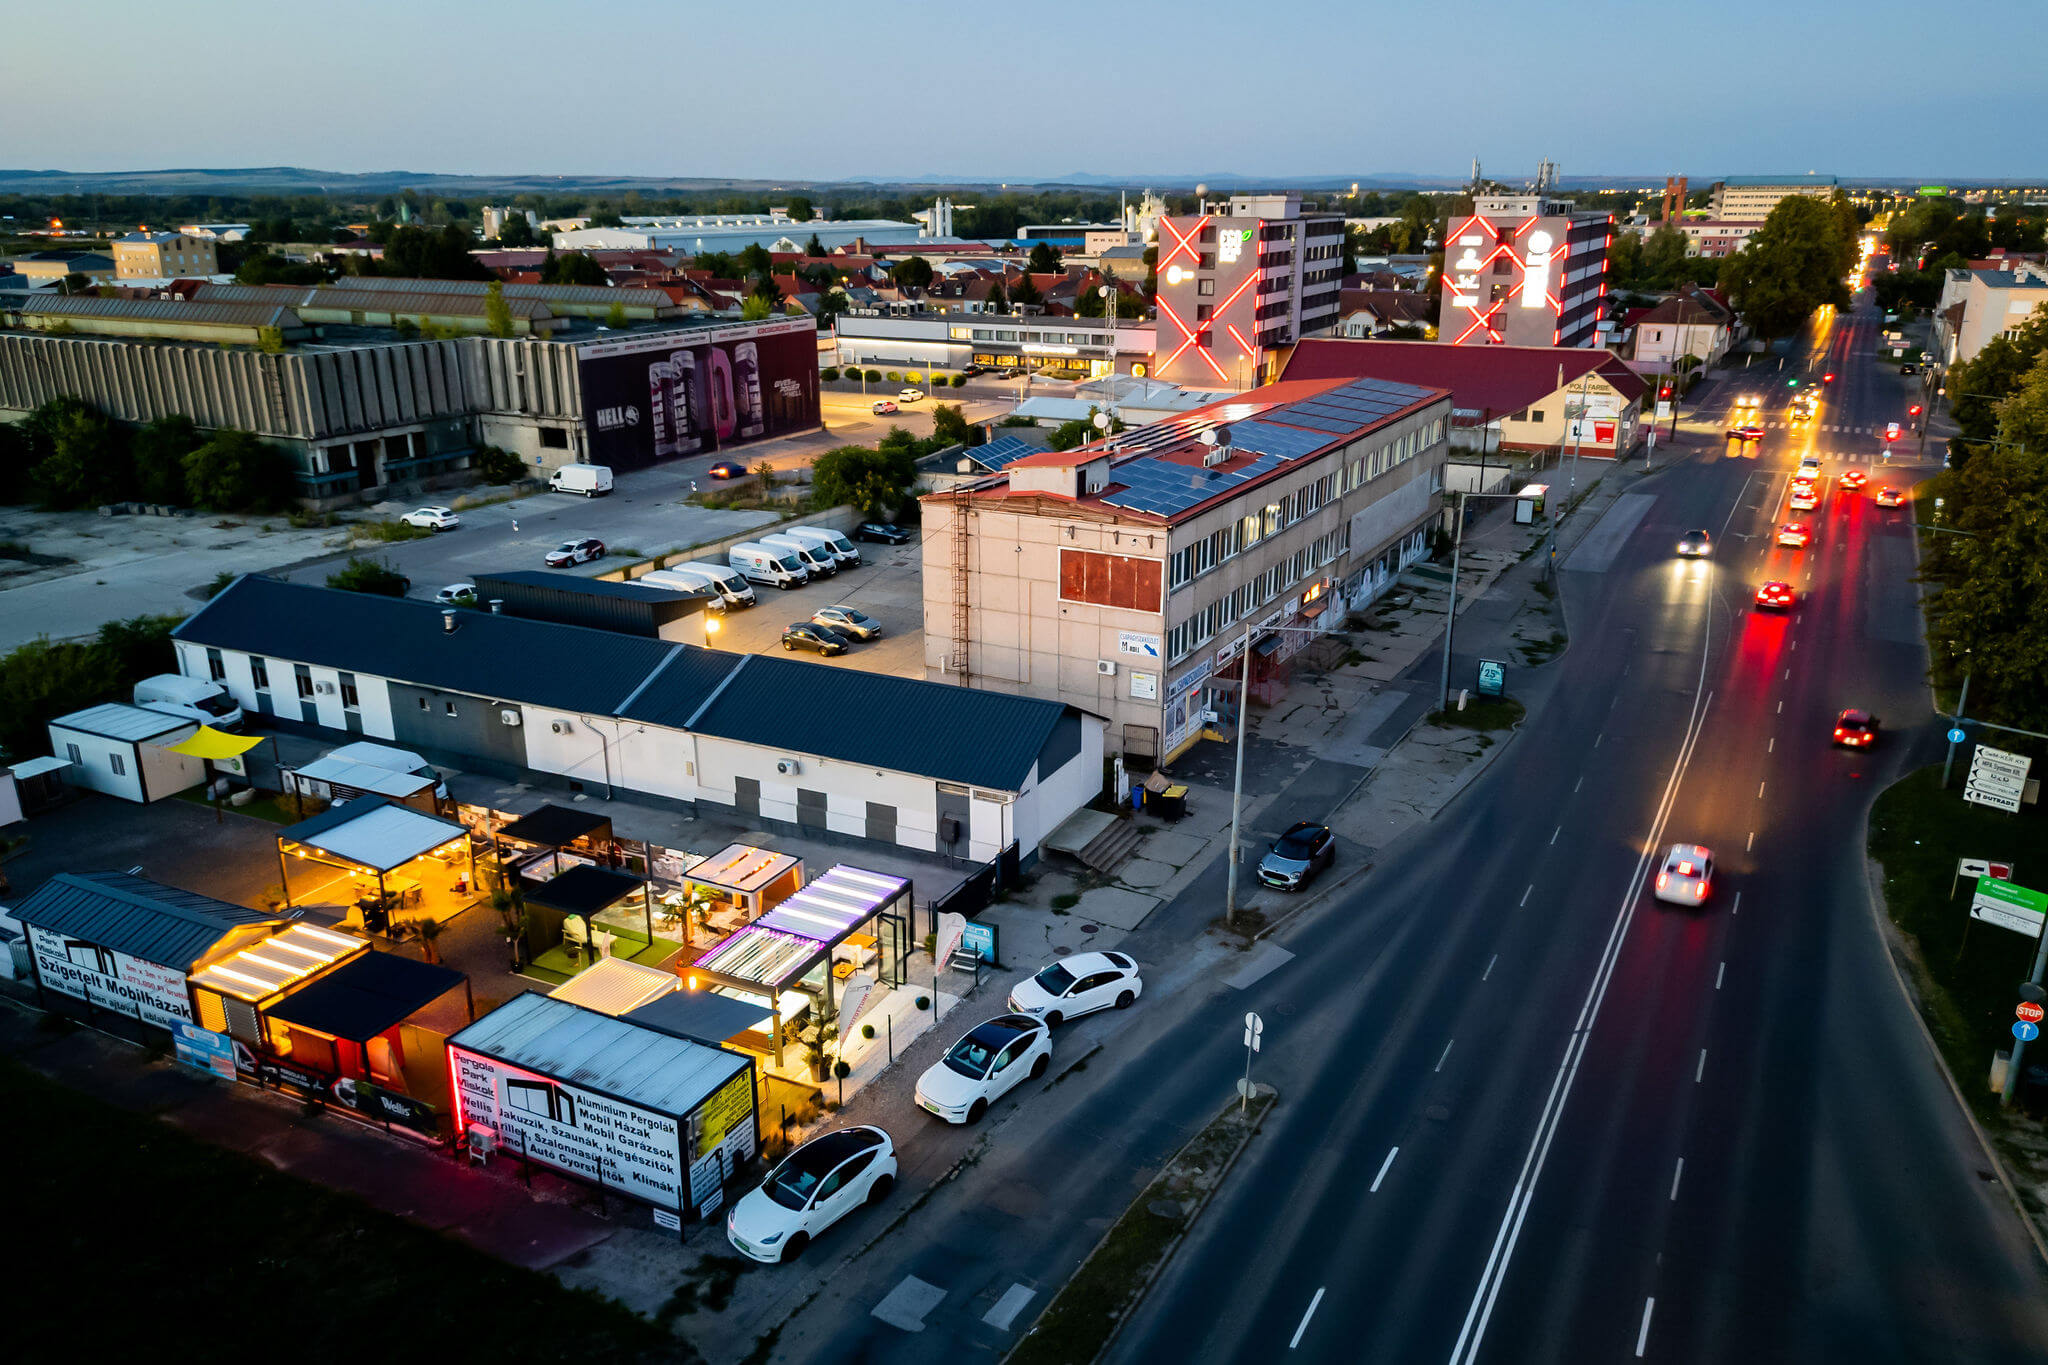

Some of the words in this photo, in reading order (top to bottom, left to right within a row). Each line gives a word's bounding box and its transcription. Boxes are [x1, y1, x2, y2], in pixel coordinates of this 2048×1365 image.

[673, 382, 688, 435] HELL
[747, 371, 762, 419] HELL
[596, 406, 624, 428] HELL
[652, 390, 666, 440] HELL
[39, 934, 58, 947] Park
[39, 956, 102, 989] Szigetelt
[106, 978, 192, 1020] Mobilházak
[2018, 1006, 2042, 1018] STOP
[453, 1052, 494, 1073] Pergola
[462, 1068, 488, 1083] Park
[381, 1096, 411, 1117] Wellis
[463, 1108, 490, 1127] Kerti
[580, 1108, 610, 1126] Mobil
[614, 1120, 651, 1140] Házak
[630, 1112, 675, 1134] Pergolák
[499, 1108, 548, 1134] Jakuzzik,
[551, 1125, 603, 1152] Szaunák,
[606, 1143, 674, 1175] kiegészítők
[584, 1122, 614, 1140] Mobil
[618, 1134, 674, 1160] Garázsok
[530, 1144, 556, 1161] Autó
[558, 1153, 626, 1185] Gyorstltők
